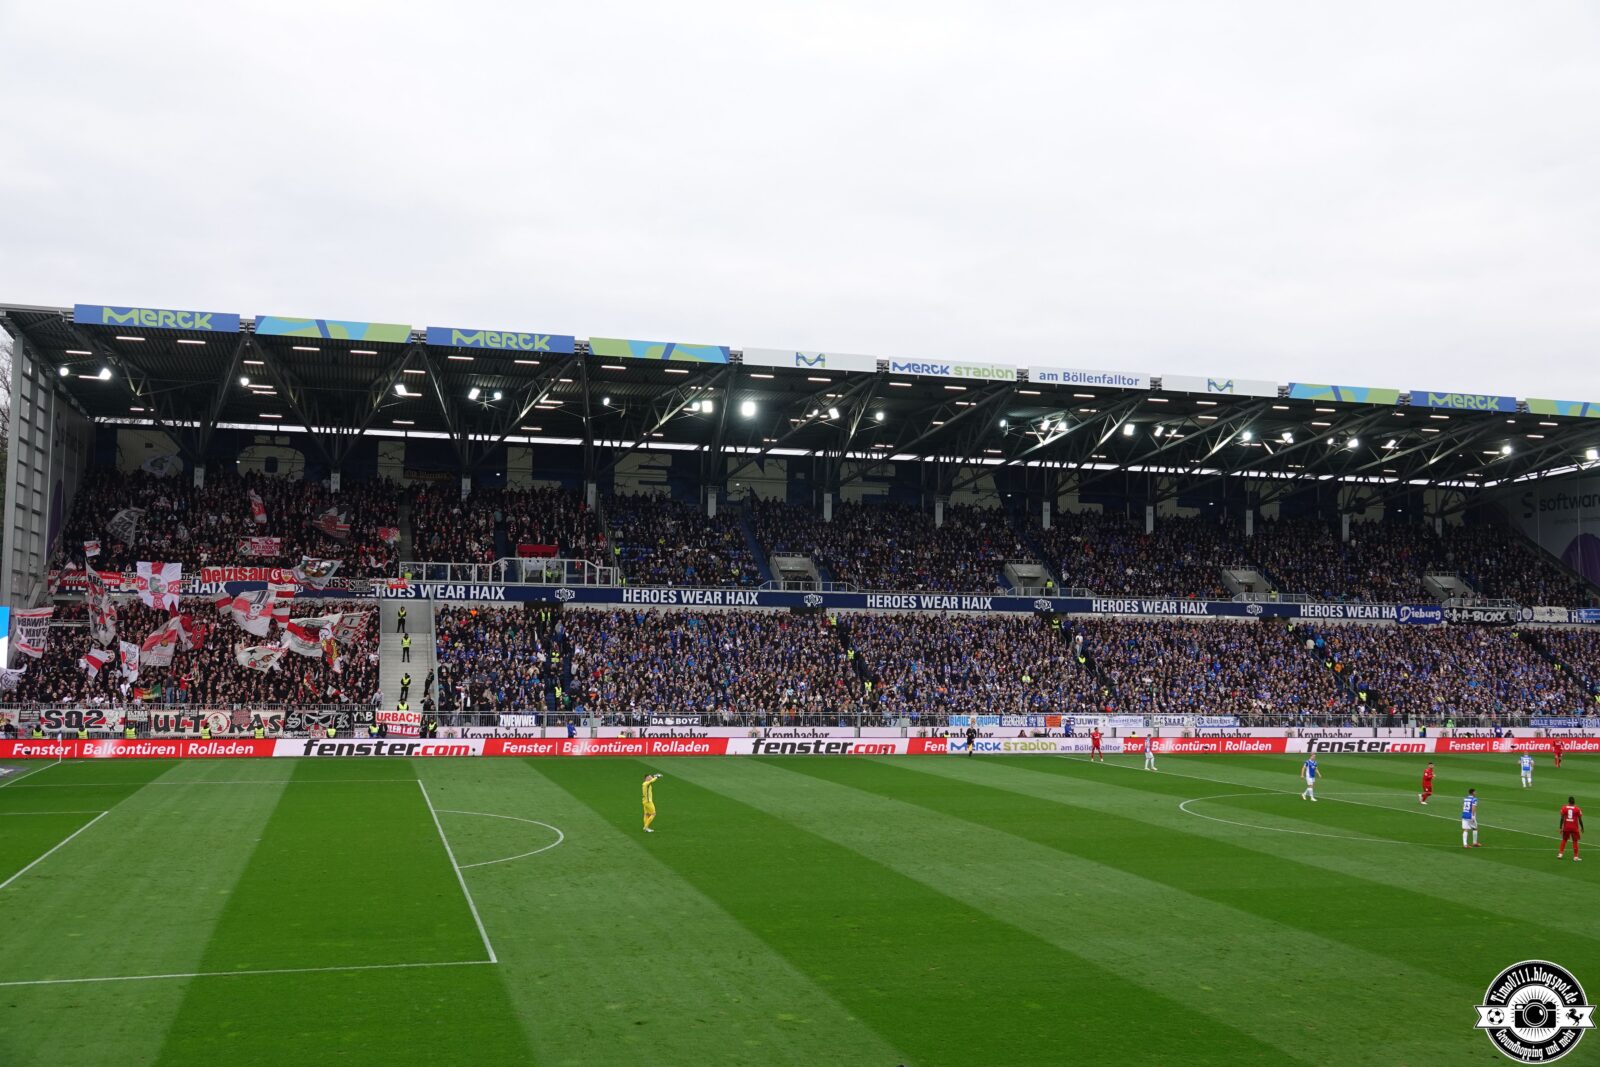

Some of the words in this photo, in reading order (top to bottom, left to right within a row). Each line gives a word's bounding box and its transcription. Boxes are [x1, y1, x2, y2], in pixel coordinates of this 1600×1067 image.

[1038, 372, 1059, 382] am
[1062, 370, 1140, 386] Böllenfalltor
[1539, 492, 1600, 512] softwar
[420, 585, 465, 599] WEAR
[470, 586, 505, 600] HAIX
[622, 589, 677, 604] HEROES
[681, 590, 723, 605] WEAR
[726, 591, 759, 606] HAIX
[866, 595, 917, 609] HEROES
[920, 596, 959, 610] WEAR
[962, 597, 992, 610] HAIX
[1092, 600, 1139, 613] HEROES
[1142, 601, 1177, 614] WEAR
[1180, 602, 1208, 615] HAIX
[1300, 604, 1343, 617] HEROES
[1346, 606, 1379, 618] WEAR
[1382, 606, 1397, 618] HA
[1400, 606, 1441, 622] Dieburg
[376, 712, 421, 723] URBACH
[652, 717, 664, 725] DA
[675, 717, 699, 725] BOYZ
[461, 728, 534, 738] Krombacher
[639, 728, 708, 738] Krombacher
[763, 728, 830, 738] Krombacher
[1194, 729, 1252, 738] Krombacher
[1297, 729, 1352, 738] Krombacher
[12, 743, 71, 756] Fenster
[83, 742, 176, 756] Balkontüren
[188, 743, 254, 755] Rolladen
[303, 739, 470, 756] fenster.com
[502, 742, 553, 753] Fenster
[562, 741, 642, 753] Balkontüren
[652, 742, 709, 753] Rolladen
[752, 738, 896, 755] fenster.com
[1074, 743, 1120, 751] Böllealltor
[1151, 740, 1217, 751] Balkontüren
[1225, 741, 1272, 751] Rolladen
[1307, 738, 1426, 753] fenster.com
[1449, 741, 1485, 751] Fenster
